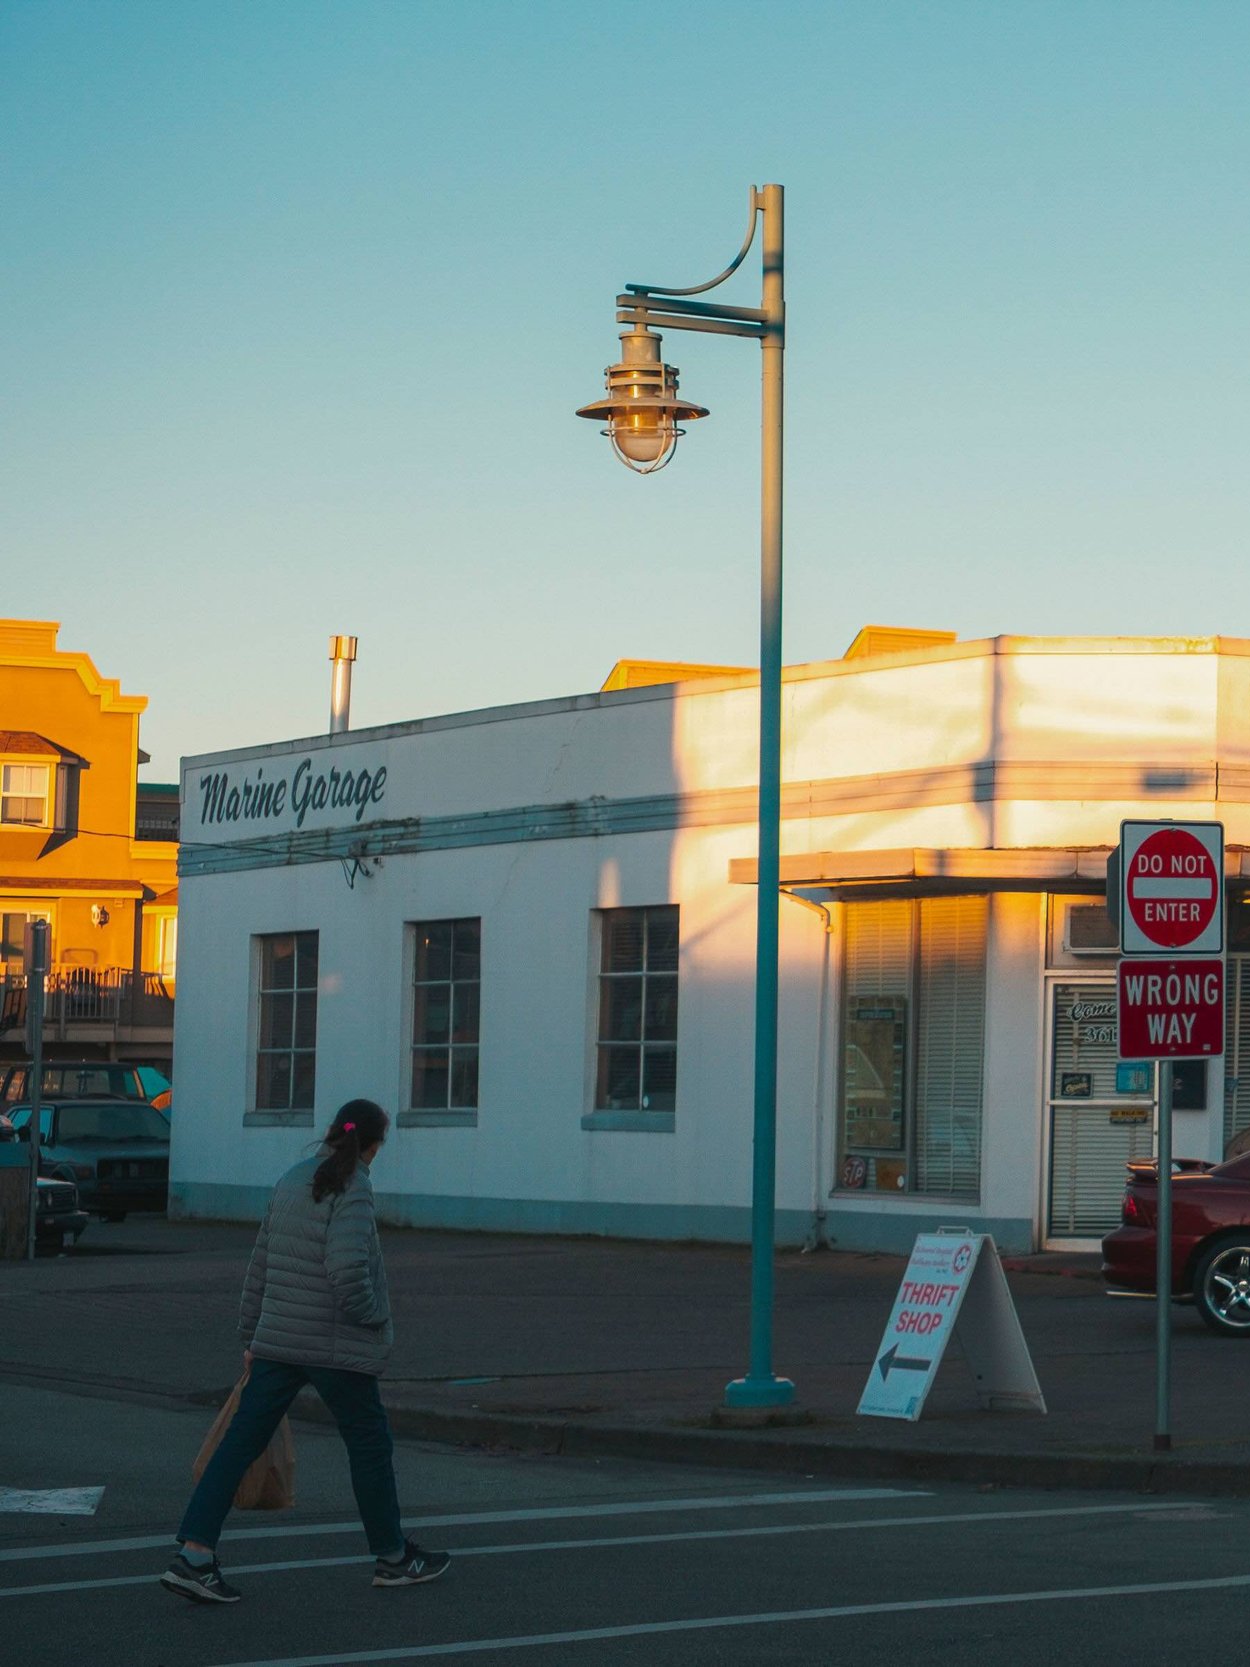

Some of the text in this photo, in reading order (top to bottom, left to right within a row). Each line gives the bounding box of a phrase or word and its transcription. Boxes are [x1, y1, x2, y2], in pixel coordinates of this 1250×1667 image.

[200, 757, 387, 828] Marine Garage
[1137, 854, 1207, 874] DO NOT
[1144, 902, 1201, 922] ENTER
[1125, 973, 1219, 1006] WRONG
[1146, 1012, 1197, 1045] WAY
[843, 1160, 864, 1184] STP
[900, 1281, 960, 1307] THRIFT
[895, 1310, 943, 1335] SHOP
